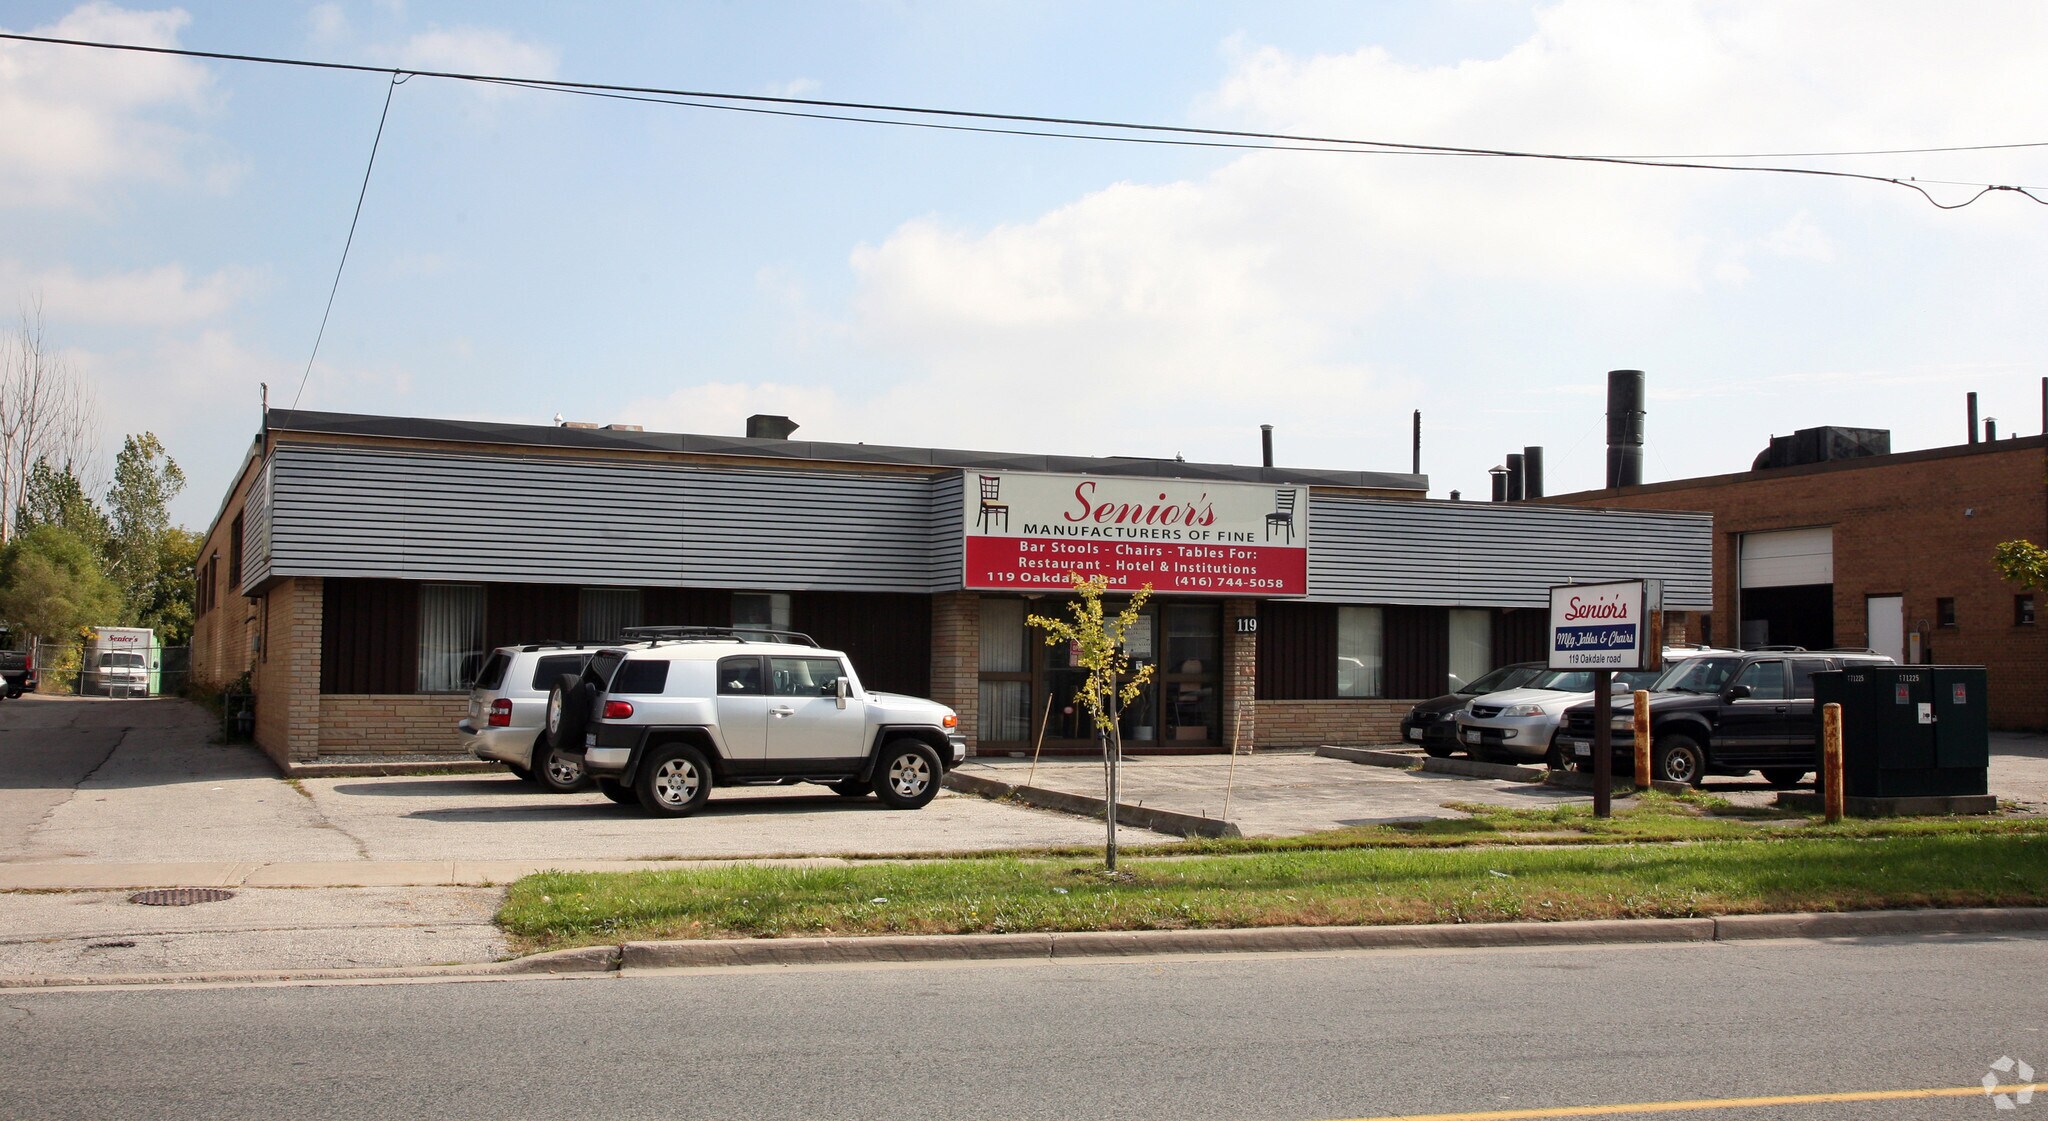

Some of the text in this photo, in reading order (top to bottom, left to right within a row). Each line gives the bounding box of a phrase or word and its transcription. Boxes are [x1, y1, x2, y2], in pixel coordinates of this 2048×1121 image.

[1063, 481, 1218, 527] Senior's
[1023, 523, 1255, 543] MANUFACTURERS OF FINE
[1020, 541, 1046, 553] Bar
[1051, 542, 1099, 554] Stools
[1115, 544, 1163, 556] Chairs
[1177, 546, 1224, 559] Tables
[1229, 548, 1257, 560] For:
[1018, 557, 1100, 570] Restaurant
[1116, 560, 1154, 572] Hotel
[1160, 562, 1169, 572] &
[1174, 562, 1257, 575] Institutions
[987, 572, 1015, 581] 119
[1020, 572, 1084, 583] Oakda
[1174, 575, 1212, 587] (416)
[1217, 577, 1284, 588] 744-5058
[1564, 594, 1627, 621] Senior's
[1236, 618, 1257, 632] 119
[1575, 632, 1598, 647] Tables
[1600, 631, 1607, 644] &
[1608, 630, 1633, 647] Chairs
[1569, 653, 1622, 664] 119 Oakdale road
